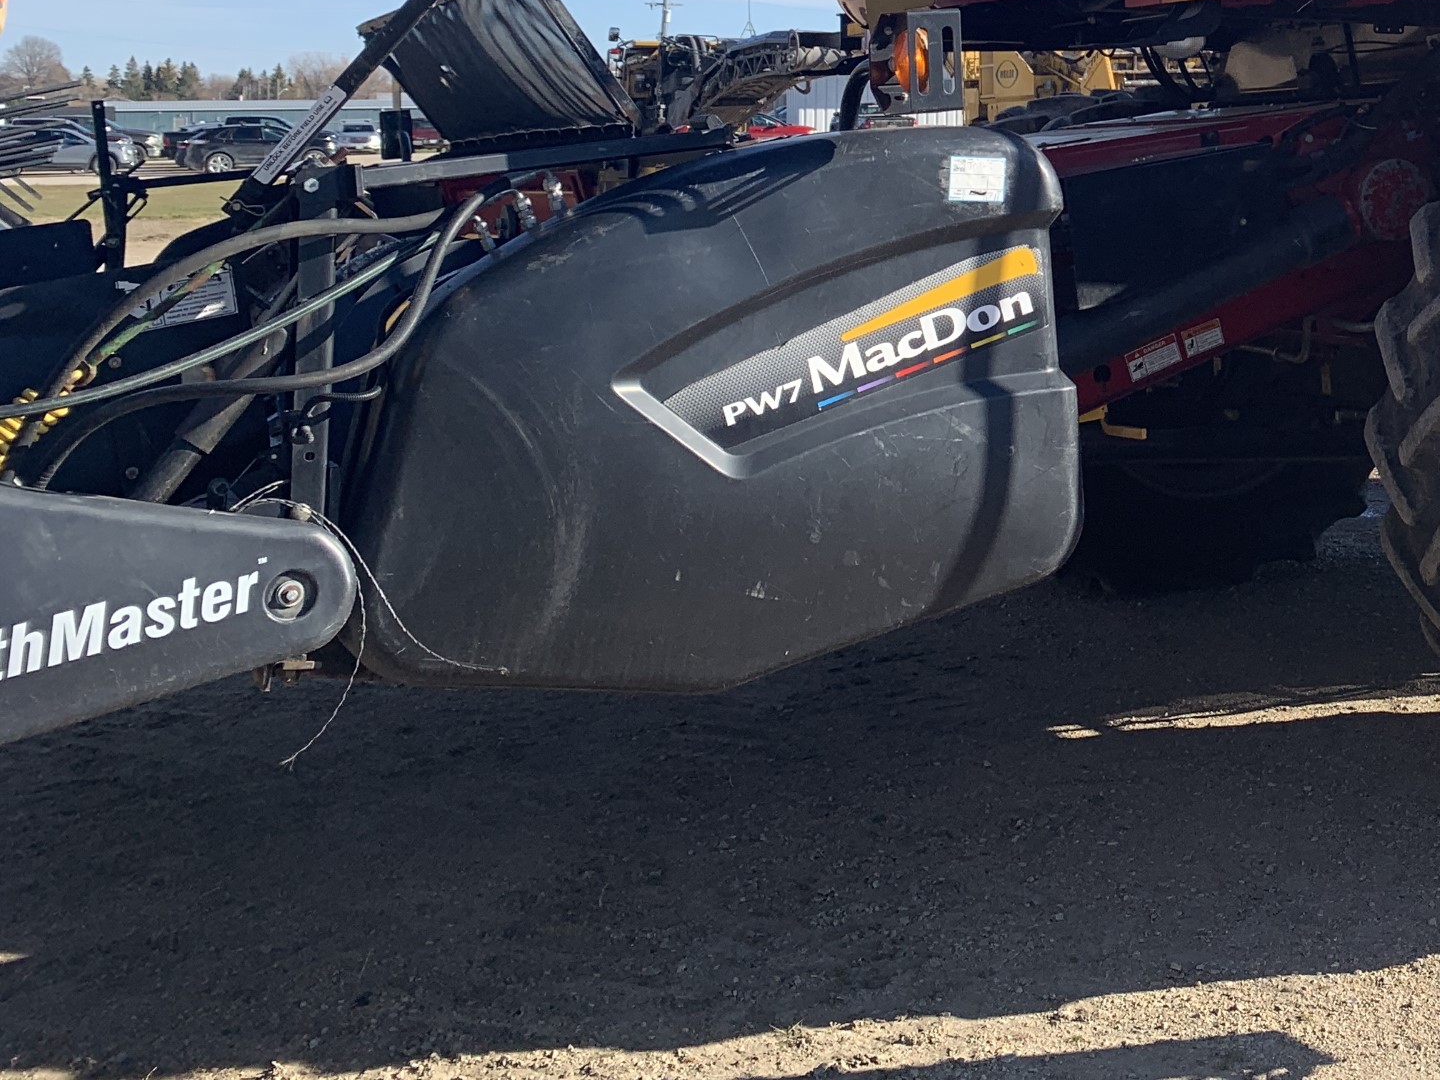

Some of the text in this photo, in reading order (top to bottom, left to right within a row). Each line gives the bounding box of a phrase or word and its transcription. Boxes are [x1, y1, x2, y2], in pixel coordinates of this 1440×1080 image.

[264, 104, 325, 172] UNLOCK BEFORE FIELD USE
[722, 291, 1034, 427] PW7 MacDon
